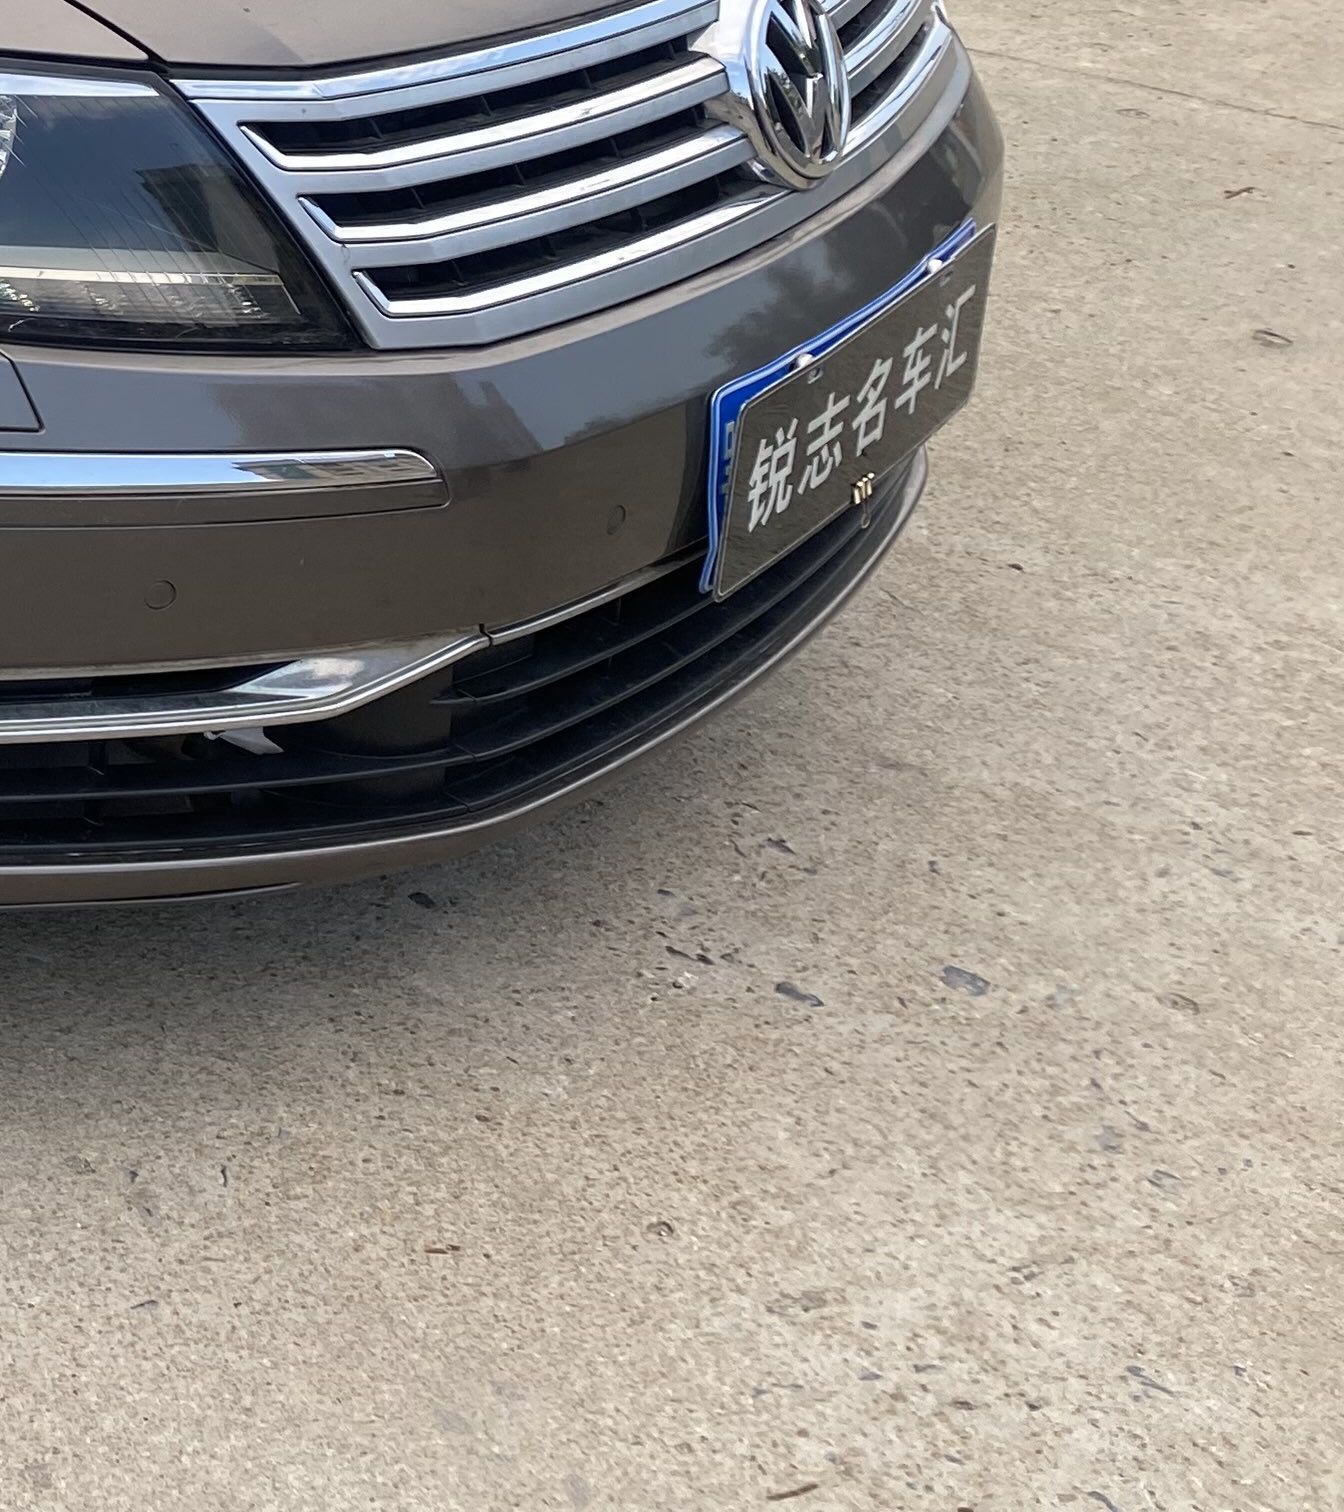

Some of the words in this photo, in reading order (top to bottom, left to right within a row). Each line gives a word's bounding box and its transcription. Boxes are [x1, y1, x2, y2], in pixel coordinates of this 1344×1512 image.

[747, 285, 976, 533] 锐志名车汇
